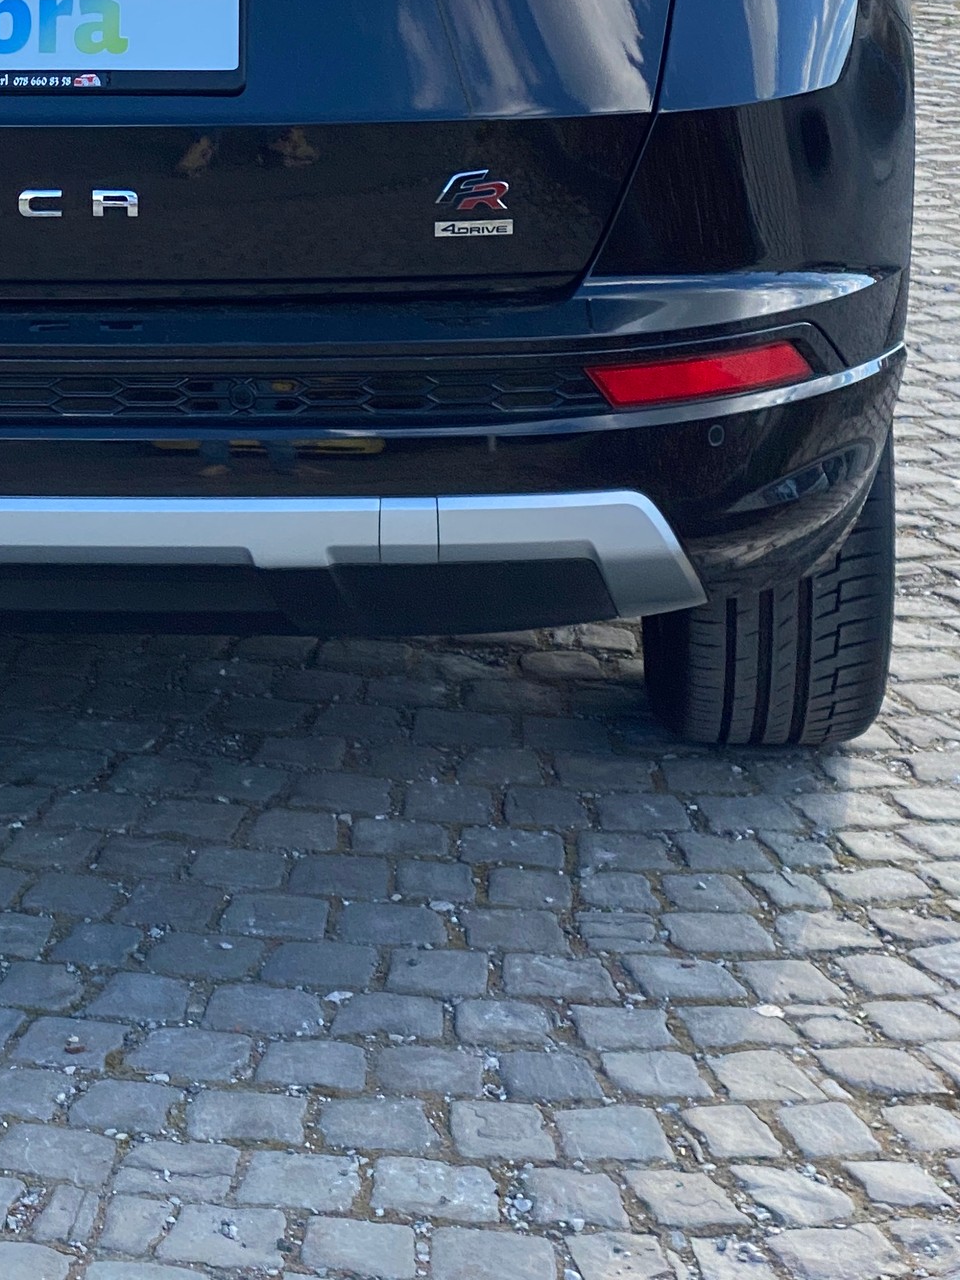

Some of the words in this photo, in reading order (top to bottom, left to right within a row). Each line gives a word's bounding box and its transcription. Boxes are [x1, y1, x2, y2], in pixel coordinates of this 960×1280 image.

[13, 76, 29, 86] 078
[30, 76, 47, 86] 660
[49, 76, 60, 86] 83
[61, 76, 72, 86] 58
[435, 169, 509, 210] FR
[441, 223, 508, 235] 4DRIVE
